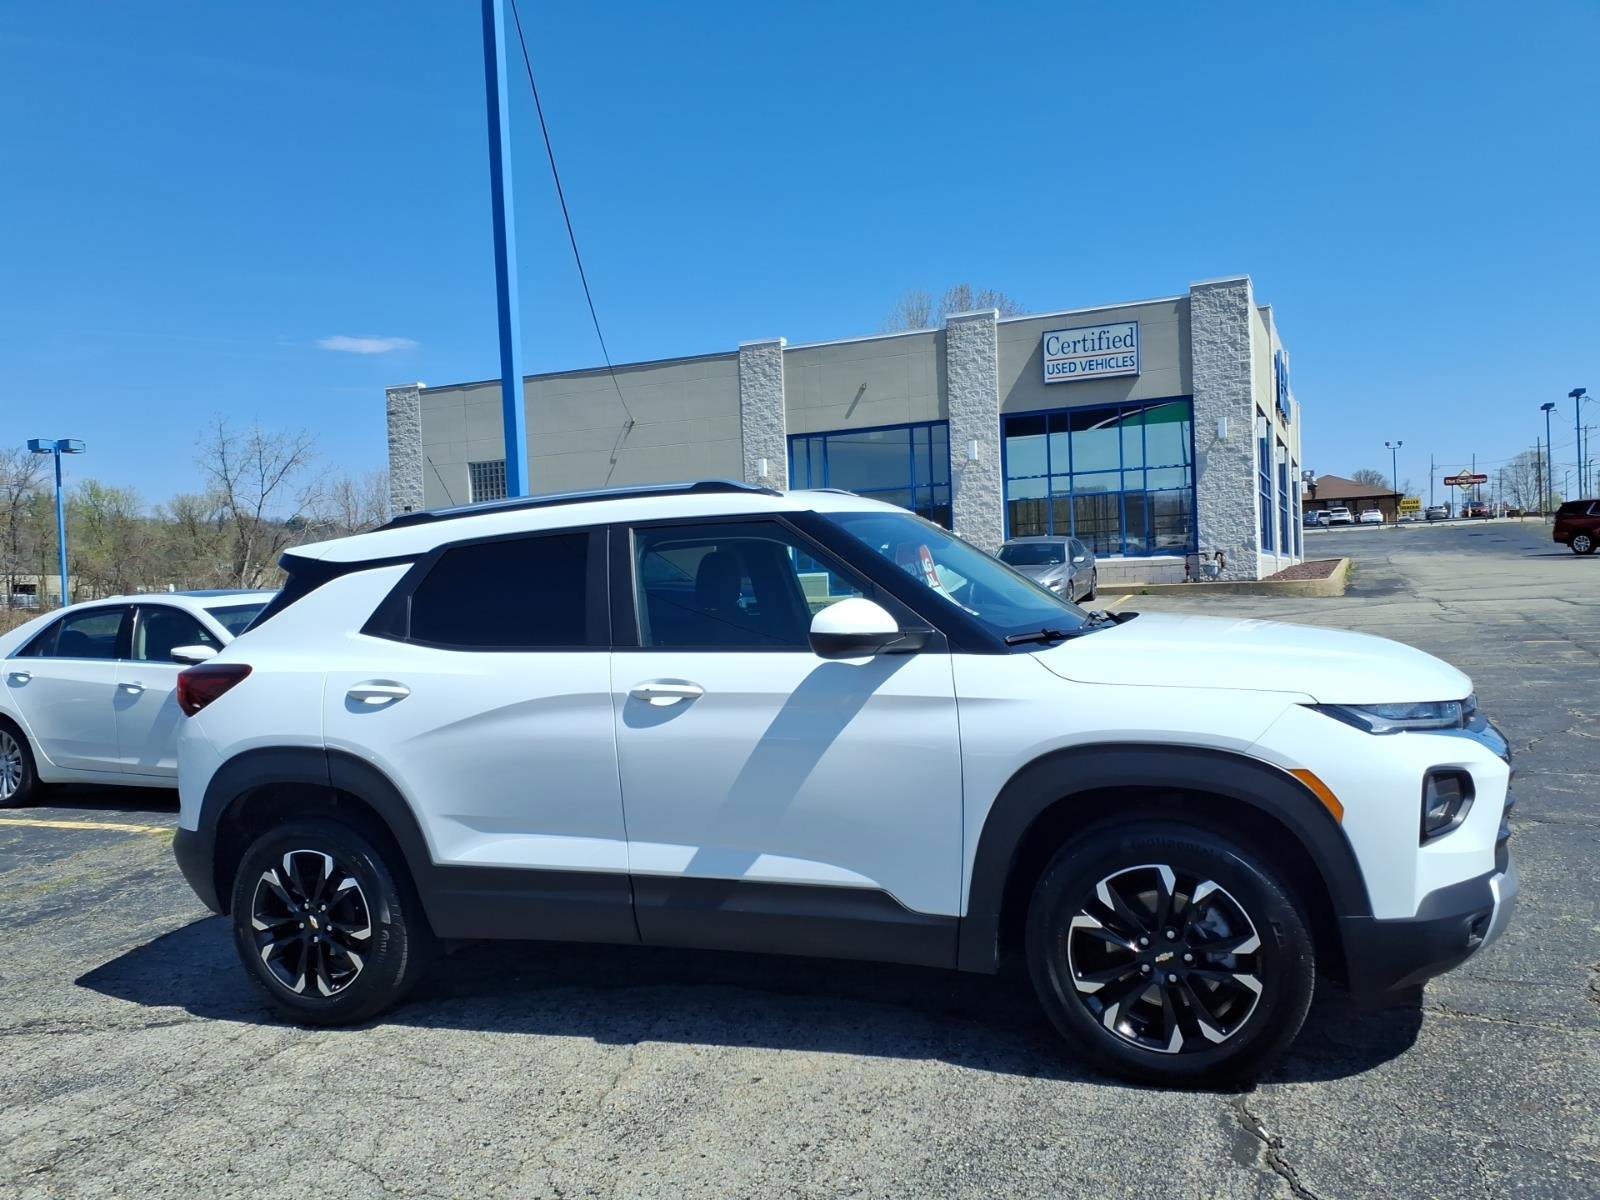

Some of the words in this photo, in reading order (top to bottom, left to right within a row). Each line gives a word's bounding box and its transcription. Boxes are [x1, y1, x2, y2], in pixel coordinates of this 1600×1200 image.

[1046, 327, 1135, 356] Certified
[1047, 361, 1077, 375] USED
[1080, 355, 1135, 371] VEHICLES
